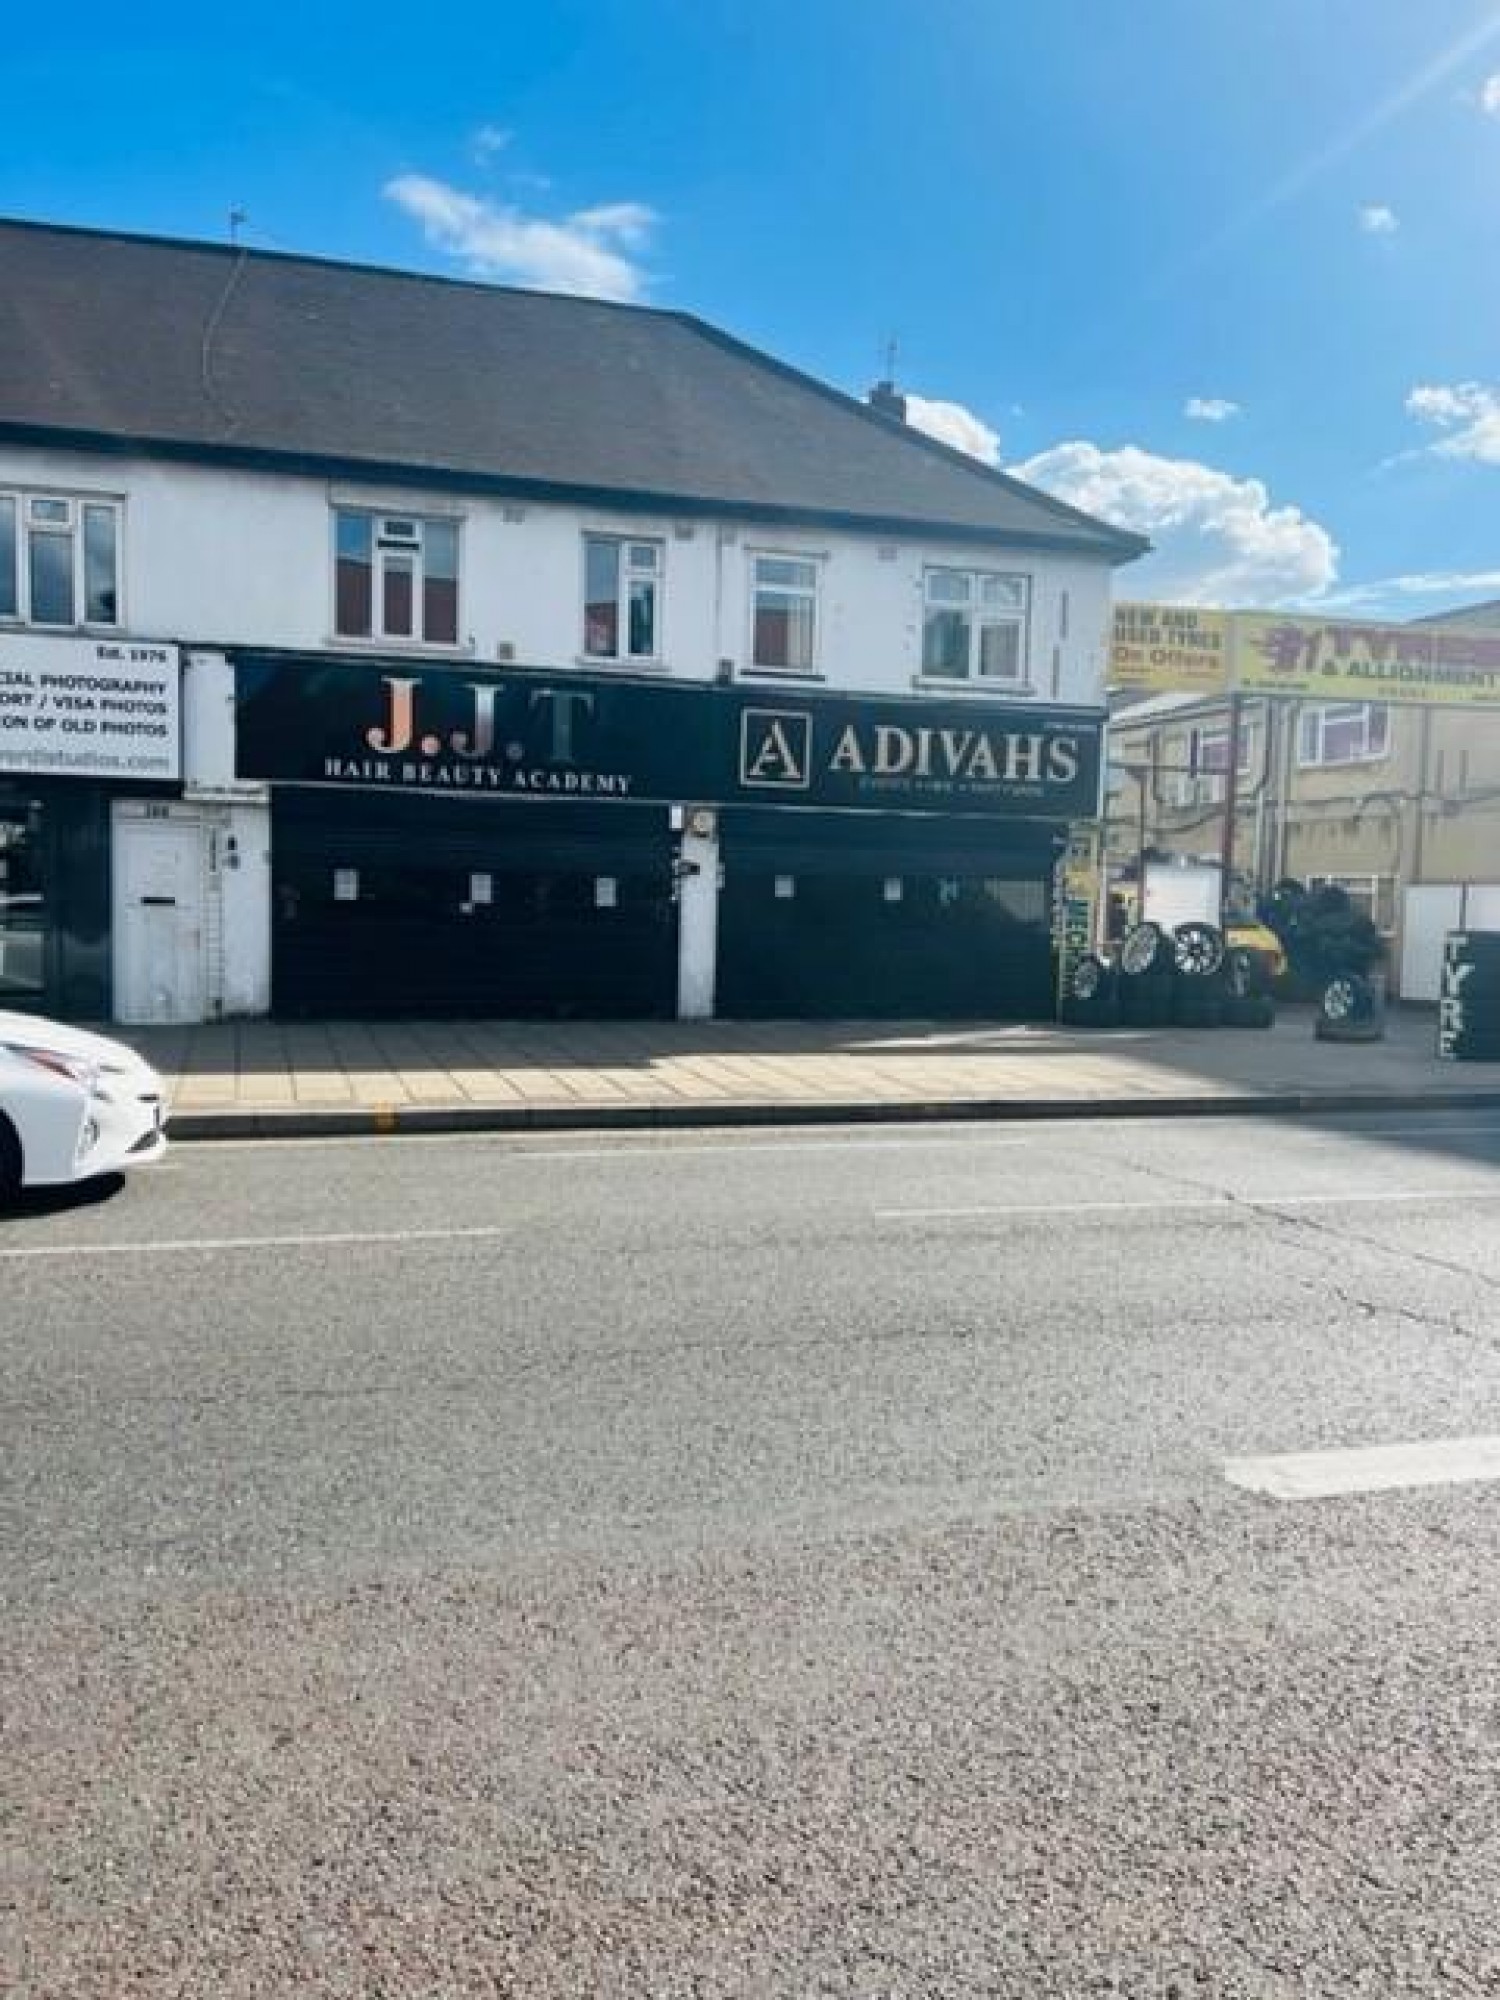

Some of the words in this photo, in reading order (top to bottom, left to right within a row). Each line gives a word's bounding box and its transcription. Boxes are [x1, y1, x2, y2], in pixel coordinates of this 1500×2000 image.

[40, 674, 167, 694] PHOTOGRAPHY
[53, 696, 95, 709] VISA
[100, 699, 168, 715] PHOTOS
[34, 718, 56, 731] OF
[61, 718, 97, 734] OLD
[100, 721, 168, 738] PHOTOS
[828, 724, 1077, 783] ADIVAHS
[324, 757, 391, 780] HAIR
[402, 762, 501, 786] BEAUTY
[514, 771, 632, 794] ACADEMY
